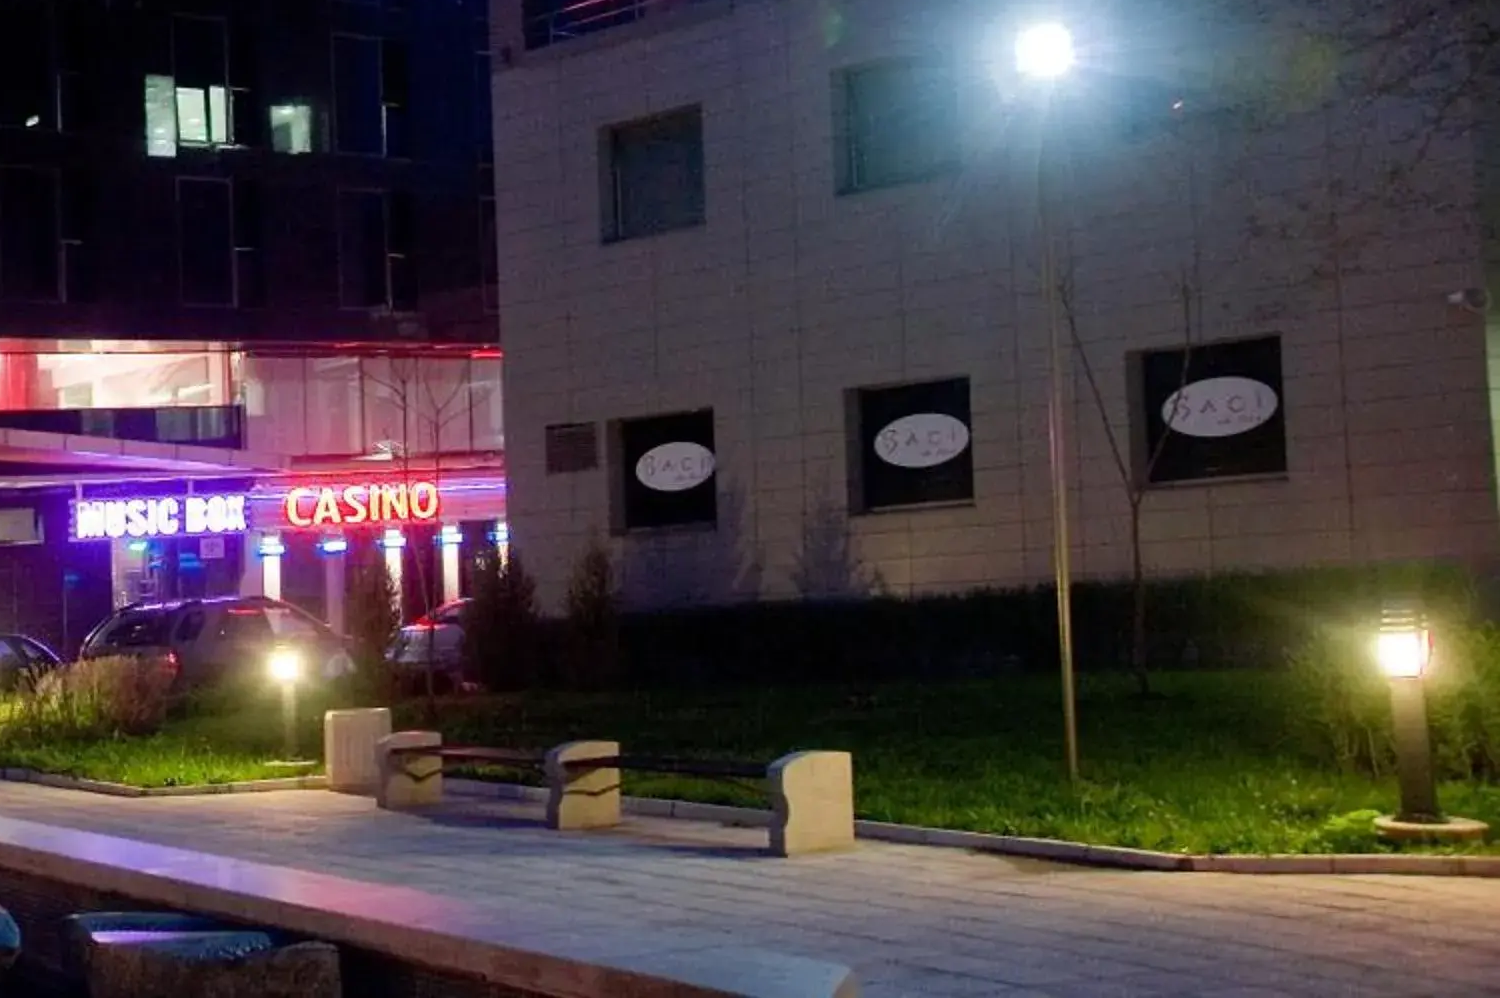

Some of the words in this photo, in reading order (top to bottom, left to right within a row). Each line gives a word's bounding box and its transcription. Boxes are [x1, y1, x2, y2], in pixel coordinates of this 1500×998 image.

[76, 496, 180, 539] MUSIC
[185, 494, 247, 533] BOX
[286, 481, 439, 527] CASINO
